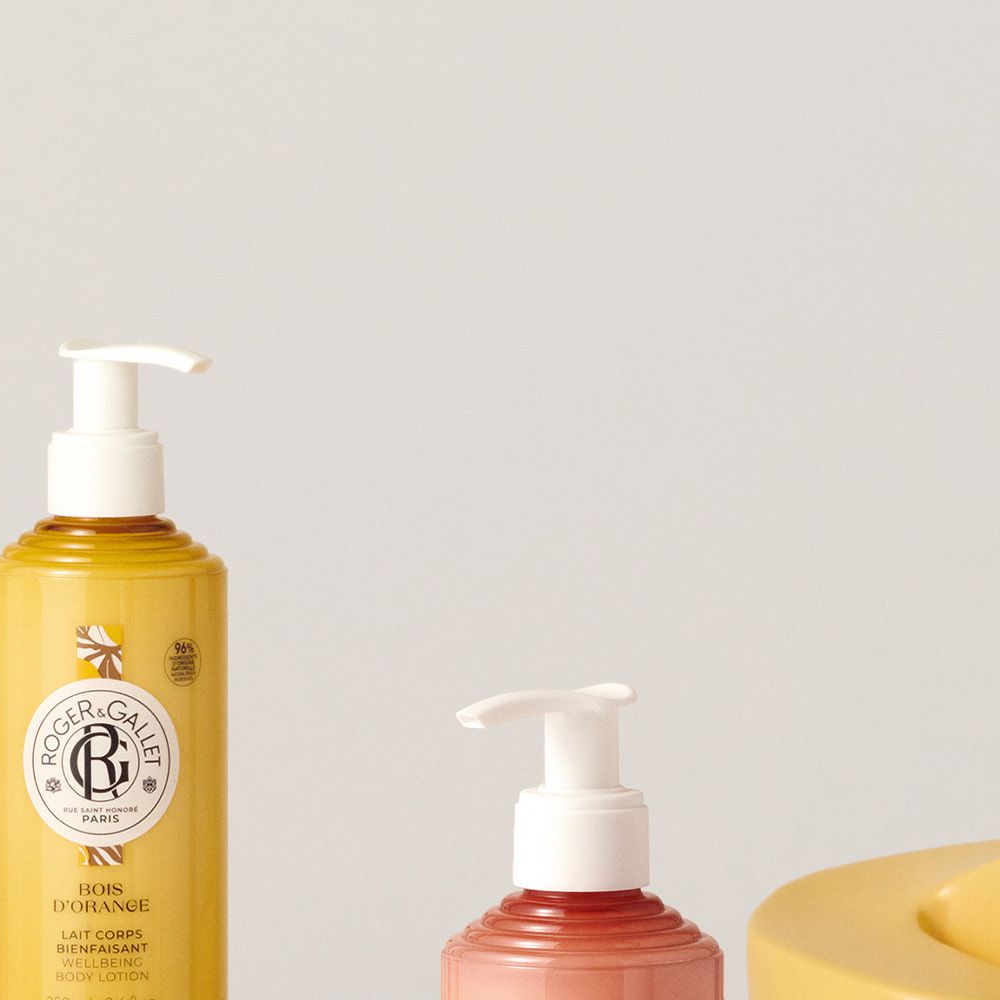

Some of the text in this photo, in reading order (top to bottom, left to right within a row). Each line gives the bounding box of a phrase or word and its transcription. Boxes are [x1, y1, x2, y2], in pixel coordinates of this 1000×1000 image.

[174, 641, 195, 654] 96%
[82, 814, 120, 824] PARIS
[79, 883, 123, 897] BOIS
[53, 899, 150, 913] D'ORANGE
[62, 929, 143, 940] LAIT CORPS
[56, 943, 148, 954] BIENFAISANT
[62, 957, 143, 968] WELLBEING
[56, 971, 149, 982] BODY LOTION
